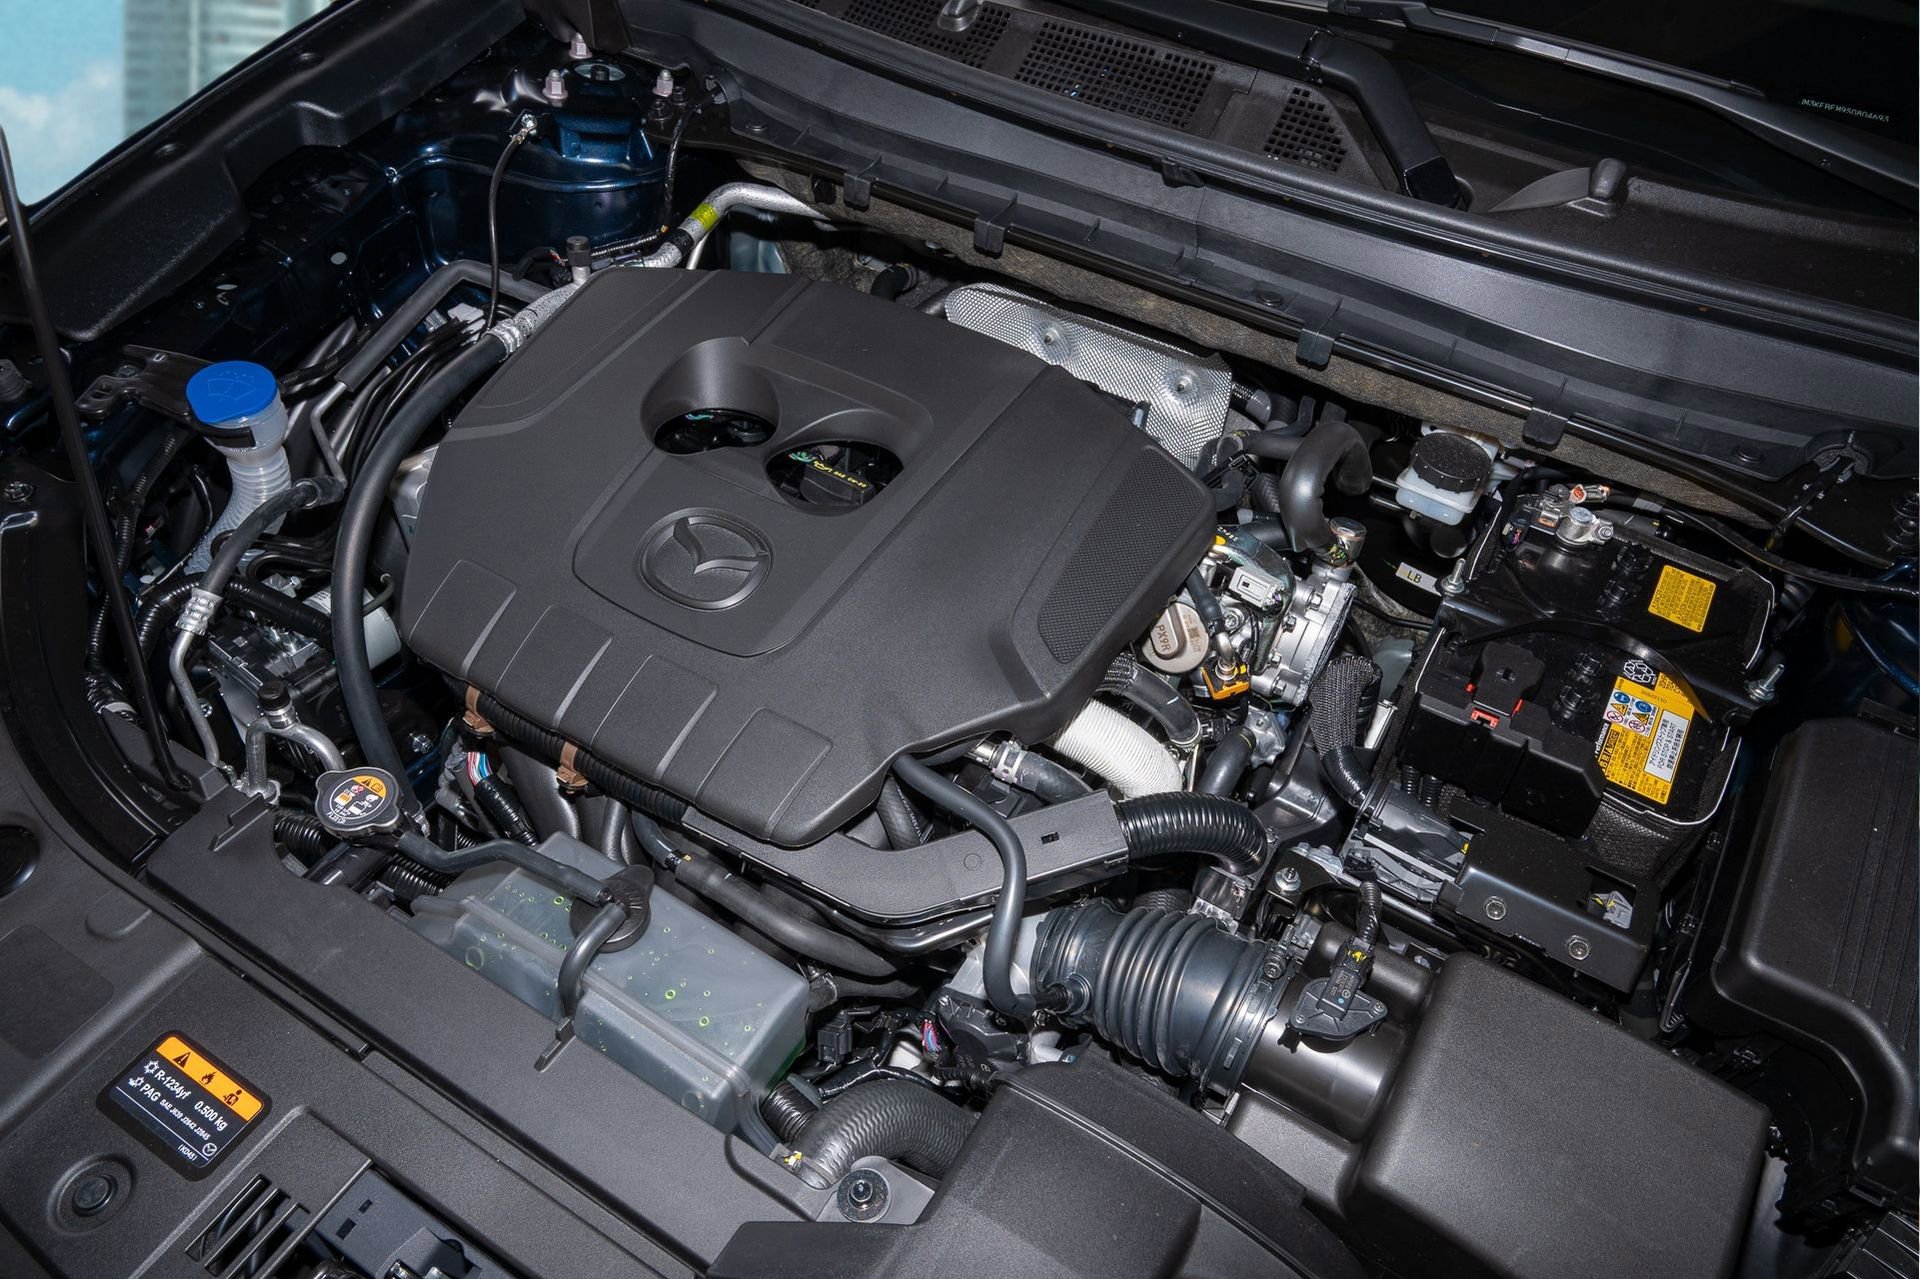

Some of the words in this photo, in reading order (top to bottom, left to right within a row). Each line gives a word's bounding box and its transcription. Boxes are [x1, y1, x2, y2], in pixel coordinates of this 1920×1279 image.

[1407, 570, 1421, 583] LB
[1155, 624, 1171, 651] PX9R
[1660, 742, 1670, 757] STOP
[1666, 722, 1677, 738] START
[139, 1082, 161, 1102] PAG
[159, 1099, 173, 1111] SAE
[155, 1069, 192, 1100] R-1234yf
[194, 1101, 219, 1122] 0.500
[214, 1115, 229, 1131] kg
